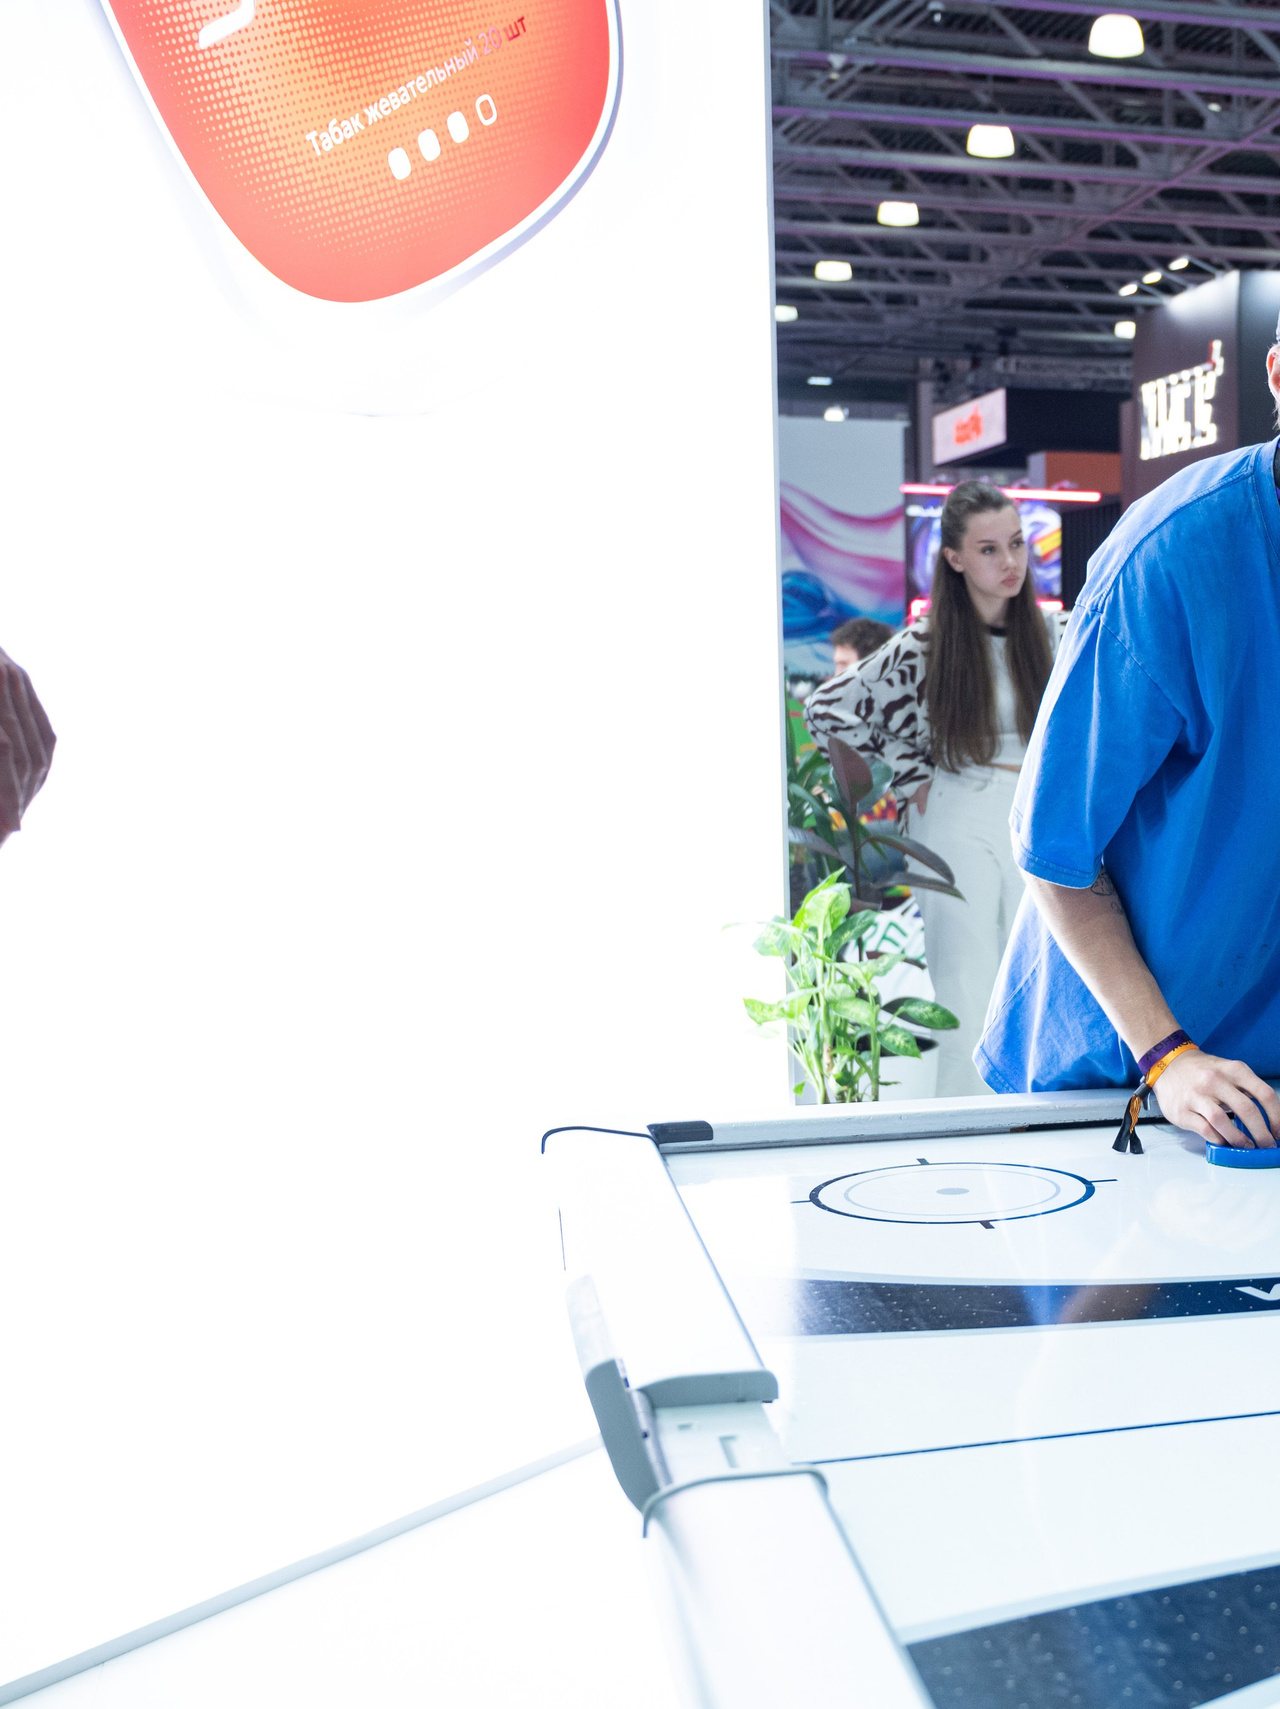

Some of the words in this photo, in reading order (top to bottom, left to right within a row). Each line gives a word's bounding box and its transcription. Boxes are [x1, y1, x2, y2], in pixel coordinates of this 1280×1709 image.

[305, 113, 366, 156] Табак
[363, 38, 480, 126] жевательный
[477, 26, 502, 56] 20
[503, 16, 527, 42] шт
